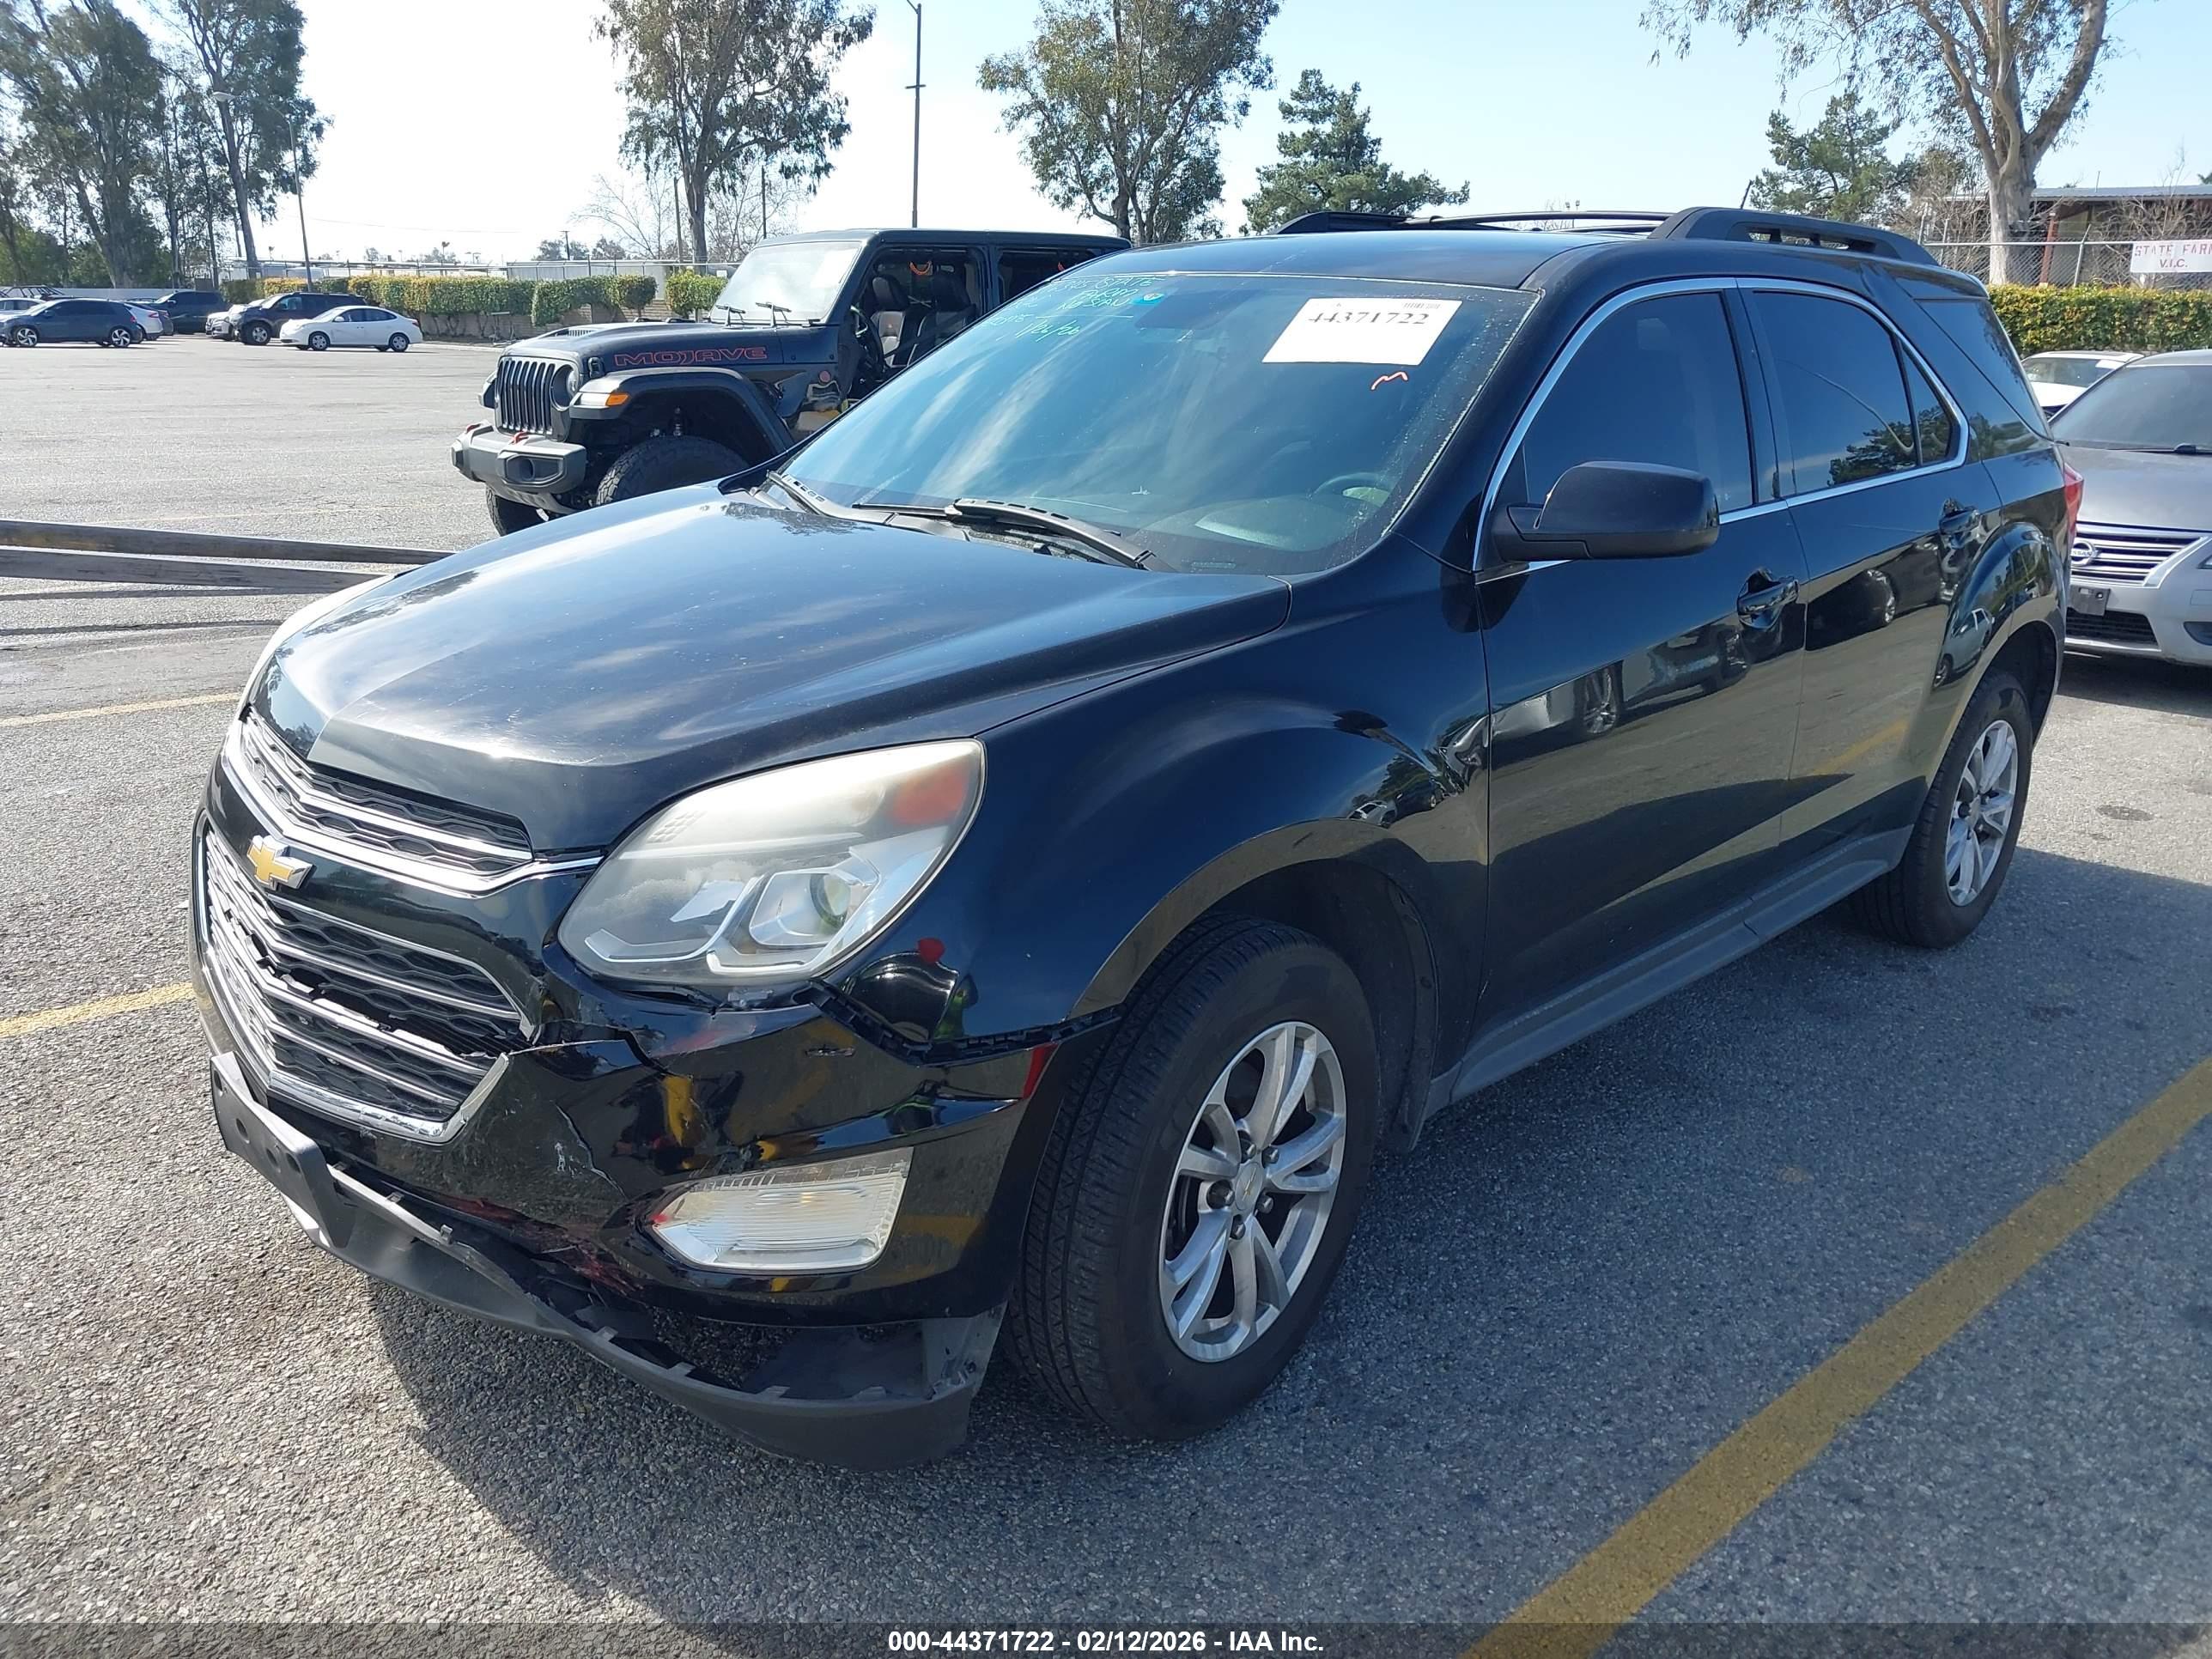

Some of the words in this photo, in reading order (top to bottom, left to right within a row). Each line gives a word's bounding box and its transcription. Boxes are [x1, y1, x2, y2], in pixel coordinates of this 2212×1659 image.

[2134, 245, 2174, 256] STATE
[2160, 258, 2189, 268] V.I.C.
[1307, 311, 1430, 325] 44371722
[614, 346, 767, 367] MOJAVE
